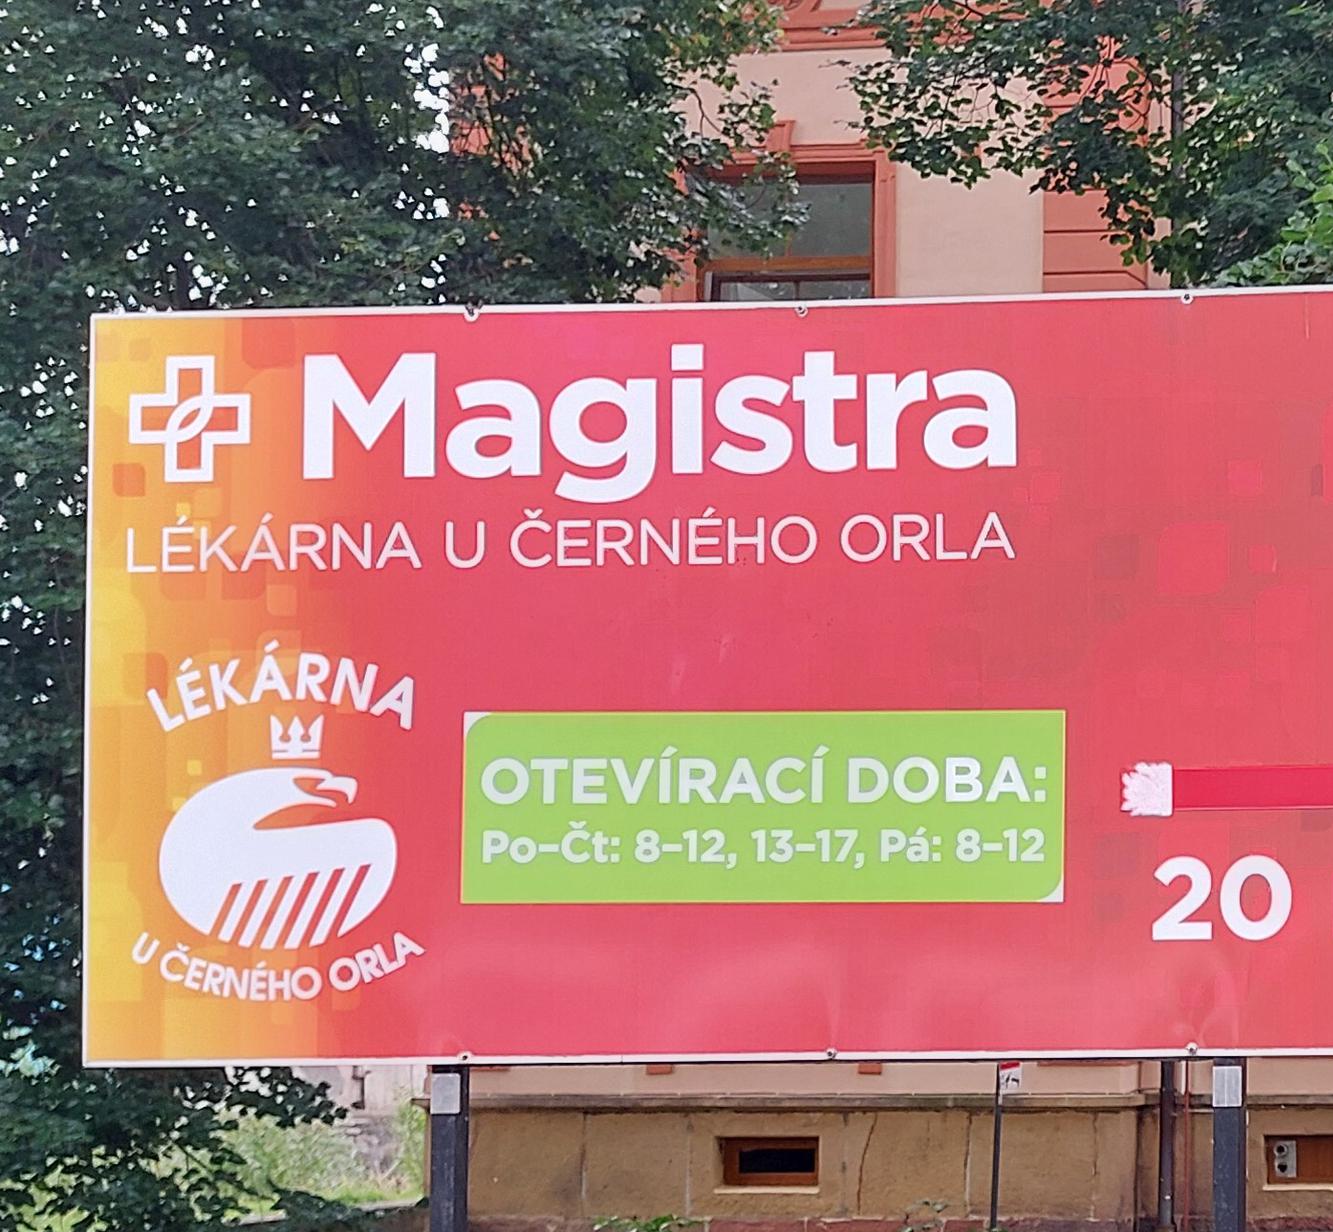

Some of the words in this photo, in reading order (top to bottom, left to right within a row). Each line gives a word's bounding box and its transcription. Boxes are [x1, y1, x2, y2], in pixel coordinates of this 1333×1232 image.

[302, 342, 1018, 503] Magistra
[126, 512, 422, 573] LÉKÁRNA
[444, 520, 486, 569] U
[509, 507, 818, 568] ČERNÉHO
[840, 511, 1016, 562] ORLA
[146, 639, 415, 732] LÉKÁRNA
[480, 745, 829, 805] OTEVÍRACÍ
[846, 755, 1048, 804] DOBA:
[879, 826, 943, 864] Pá:
[1151, 854, 1293, 942] 20
[131, 932, 160, 965] U
[159, 943, 323, 1002] ČERNÉHO
[329, 931, 426, 992] ORLA
